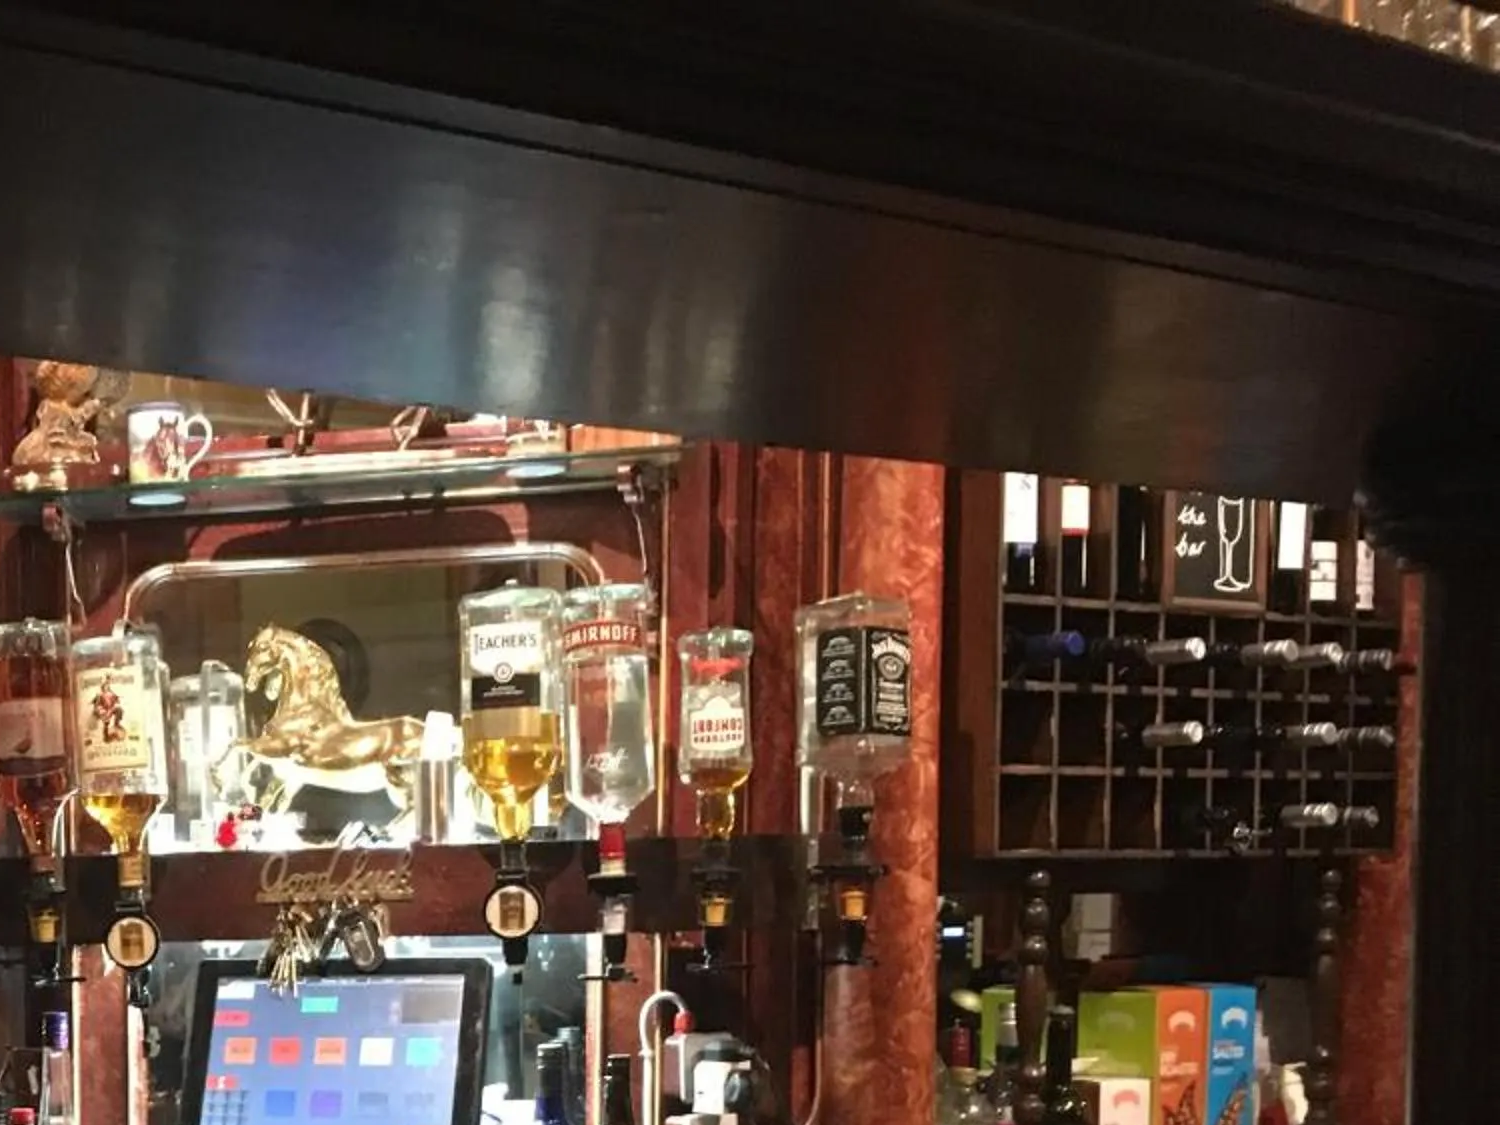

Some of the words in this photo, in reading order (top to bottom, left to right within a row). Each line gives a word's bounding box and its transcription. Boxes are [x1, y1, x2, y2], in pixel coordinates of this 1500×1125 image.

[1178, 502, 1207, 525] the
[1175, 532, 1207, 558] bar
[473, 631, 538, 655] TEACHER'S
[564, 623, 637, 648] SMIRNOFF
